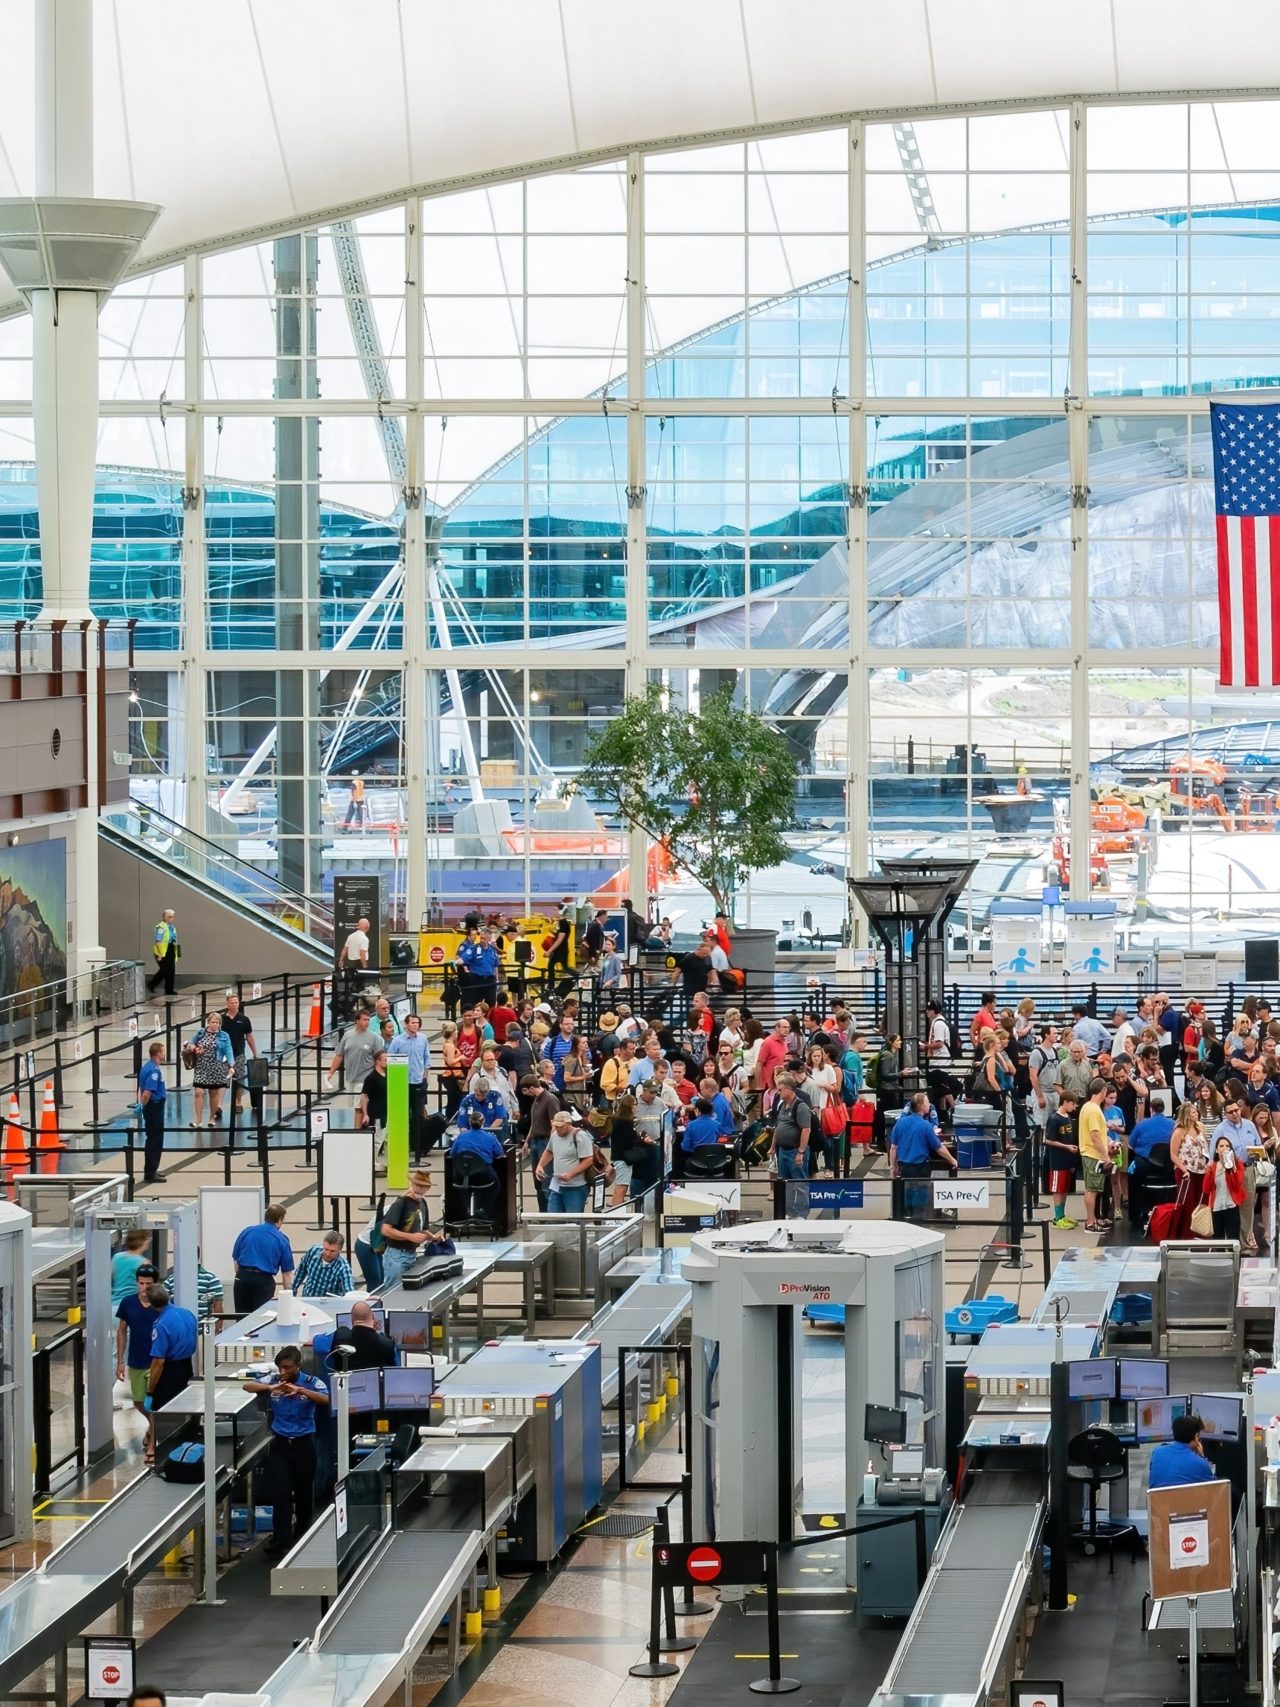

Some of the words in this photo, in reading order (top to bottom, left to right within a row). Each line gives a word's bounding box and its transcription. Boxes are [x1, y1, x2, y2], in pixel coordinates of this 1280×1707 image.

[810, 1192, 823, 1200] TSA
[936, 1191, 953, 1200] TSA
[790, 1284, 831, 1292] ProVision
[813, 1292, 831, 1300] ATD
[205, 1324, 211, 1335] 3
[1056, 1327, 1062, 1338] 5
[338, 1377, 344, 1390] 4
[1247, 1383, 1253, 1395] 6
[1182, 1541, 1197, 1549] STOP
[103, 1671, 120, 1679] STOP
